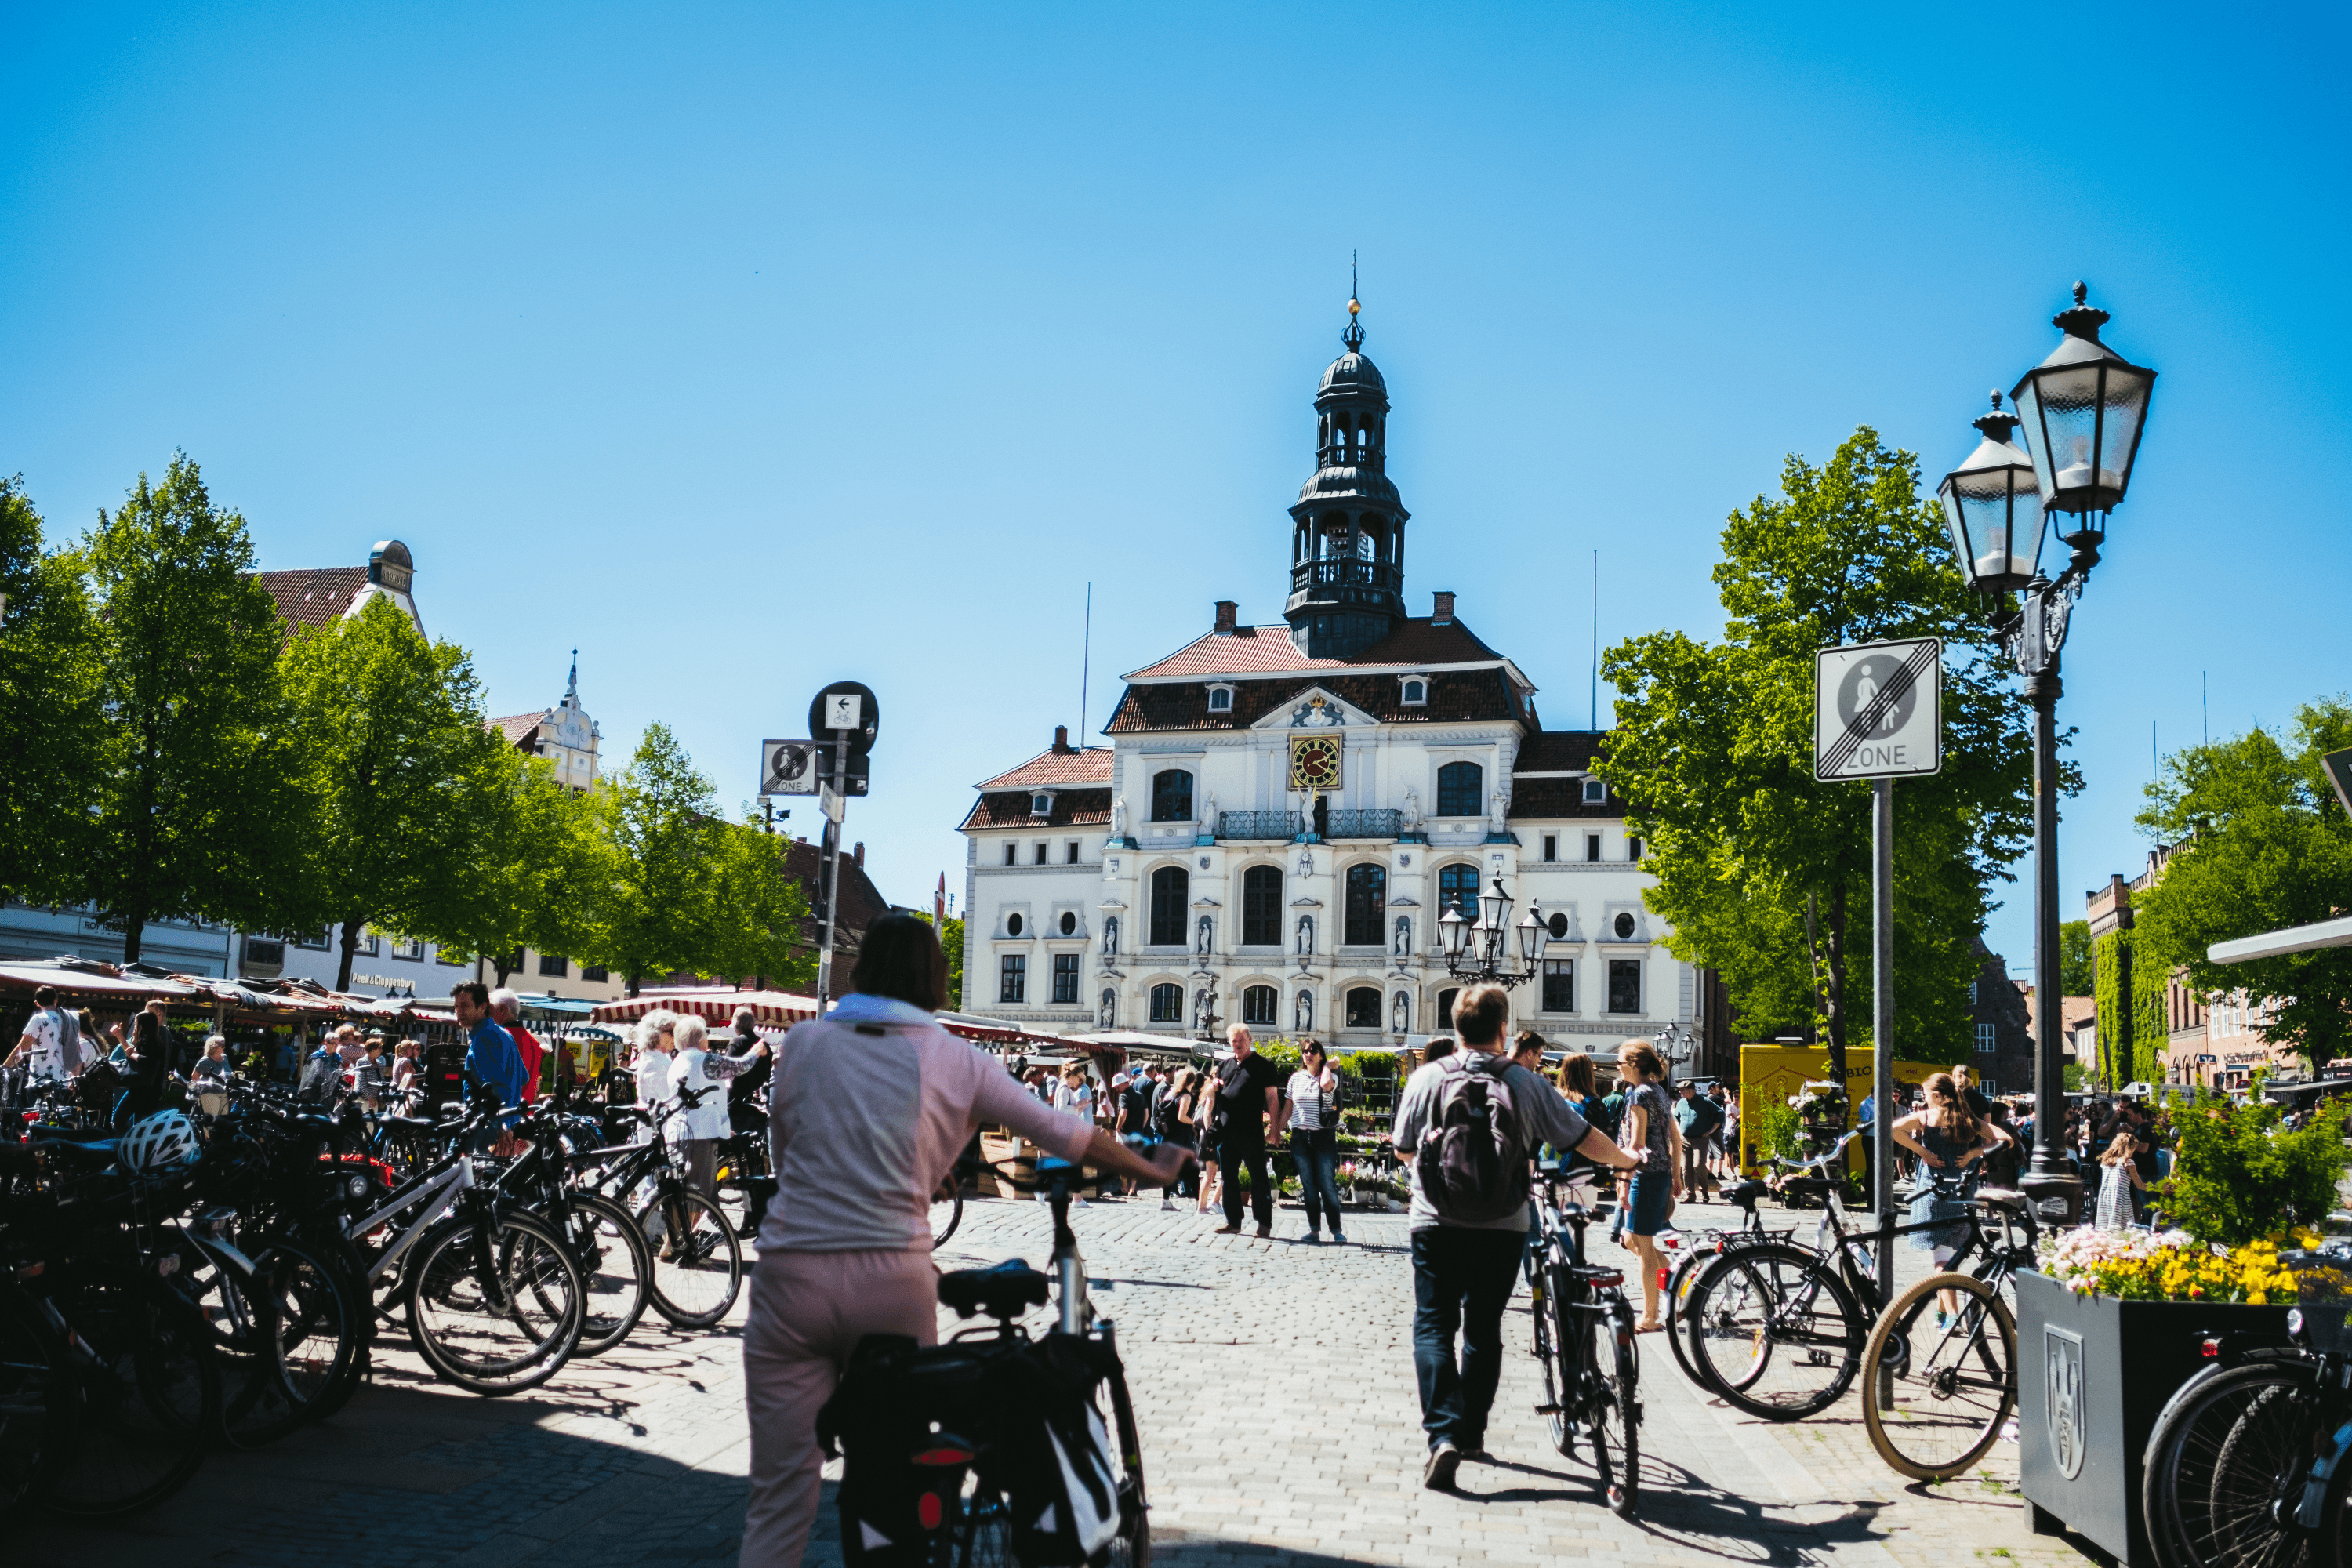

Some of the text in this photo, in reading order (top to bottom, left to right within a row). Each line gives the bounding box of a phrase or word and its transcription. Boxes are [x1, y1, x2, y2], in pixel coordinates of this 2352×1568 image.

[1846, 745, 1907, 768] ZONE
[775, 782, 803, 791] ZONE
[84, 921, 100, 930] ROY
[1846, 1066, 1872, 1078] BIO
